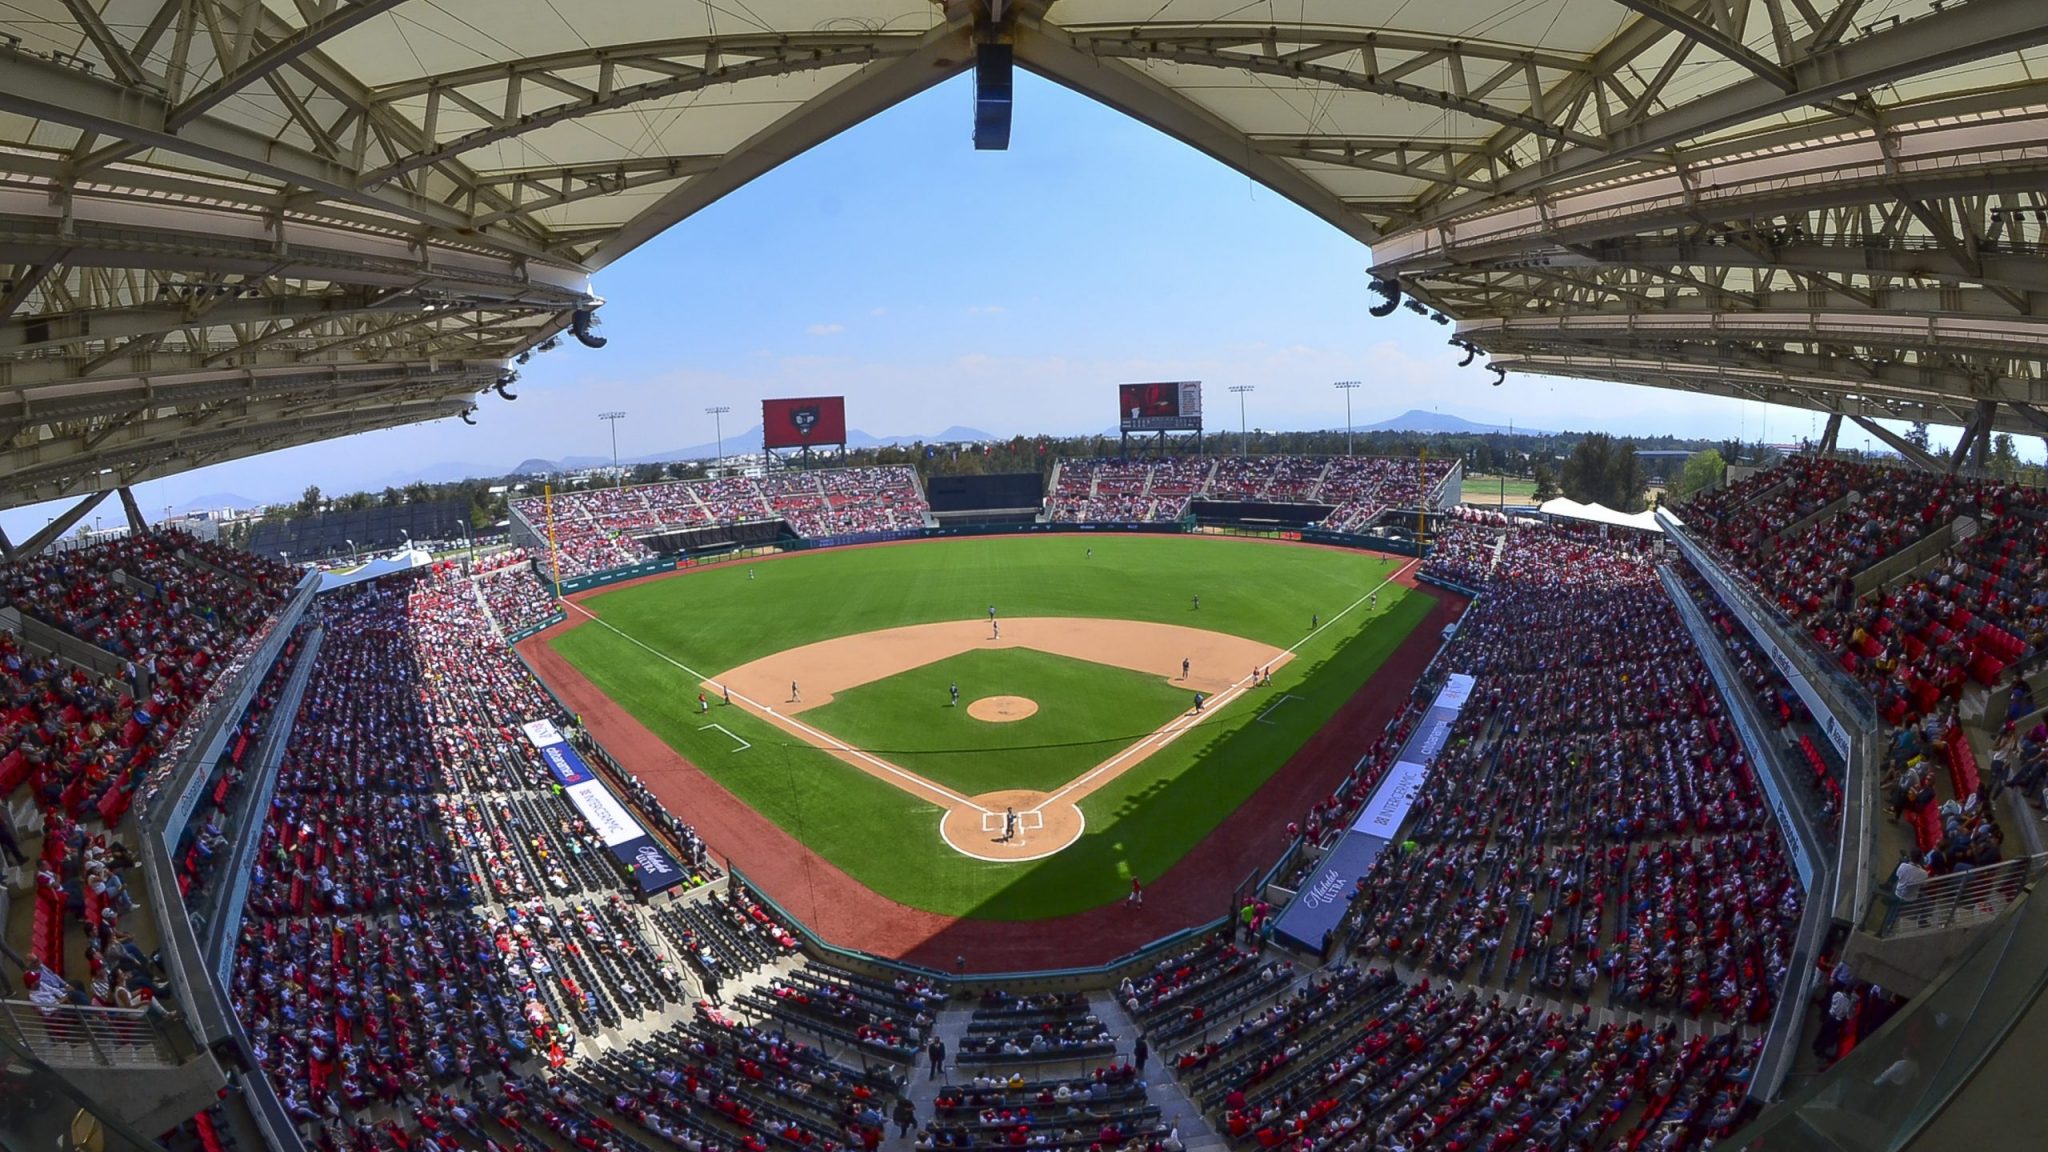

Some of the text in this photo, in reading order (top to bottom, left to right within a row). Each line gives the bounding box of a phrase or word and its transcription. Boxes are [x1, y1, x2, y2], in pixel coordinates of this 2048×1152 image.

[1382, 772, 1417, 822] INTERCERAMIC
[635, 854, 656, 874] ULTRA
[1303, 869, 1339, 909] Michelob
[1321, 879, 1348, 905] ULTRA
